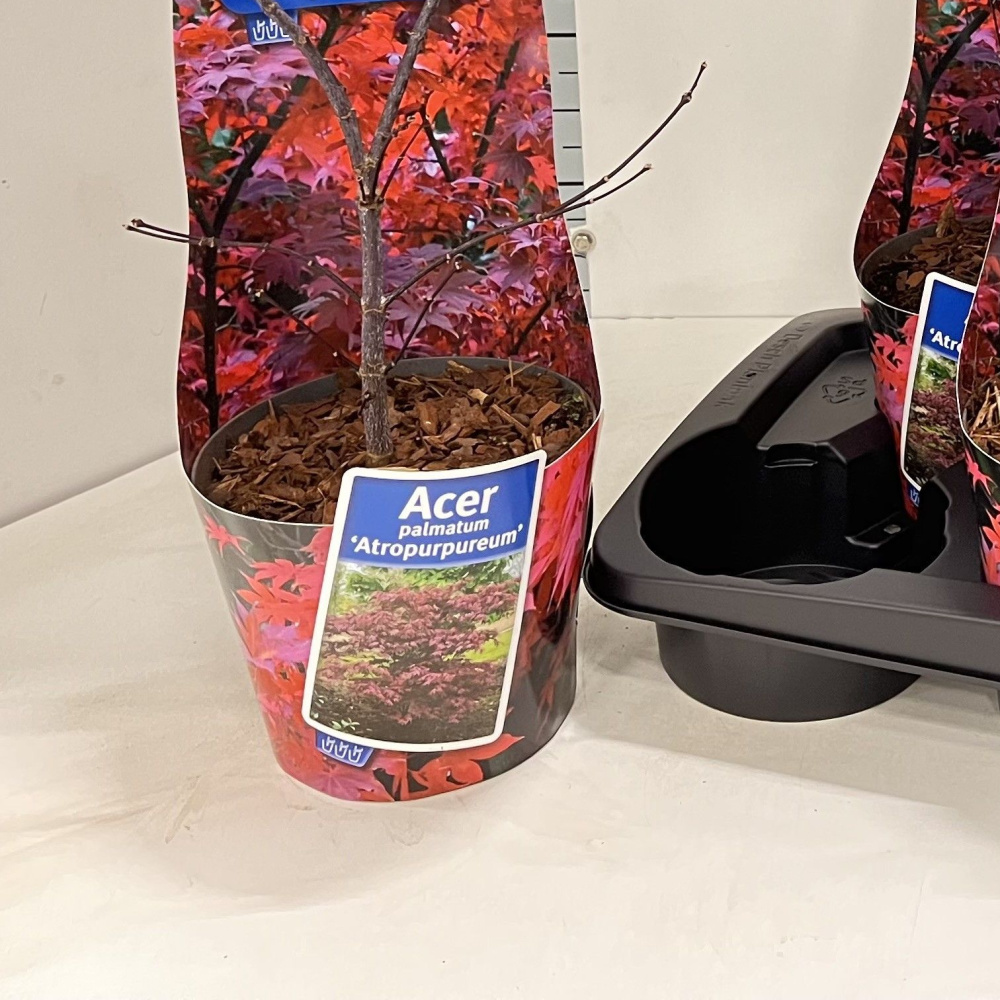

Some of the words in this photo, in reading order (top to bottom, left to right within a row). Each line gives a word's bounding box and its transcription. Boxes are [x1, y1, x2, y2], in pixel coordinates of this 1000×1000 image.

[397, 484, 500, 520] Acer
[350, 523, 524, 562] ‘Atropurpureum’
[397, 518, 490, 540] palmatum
